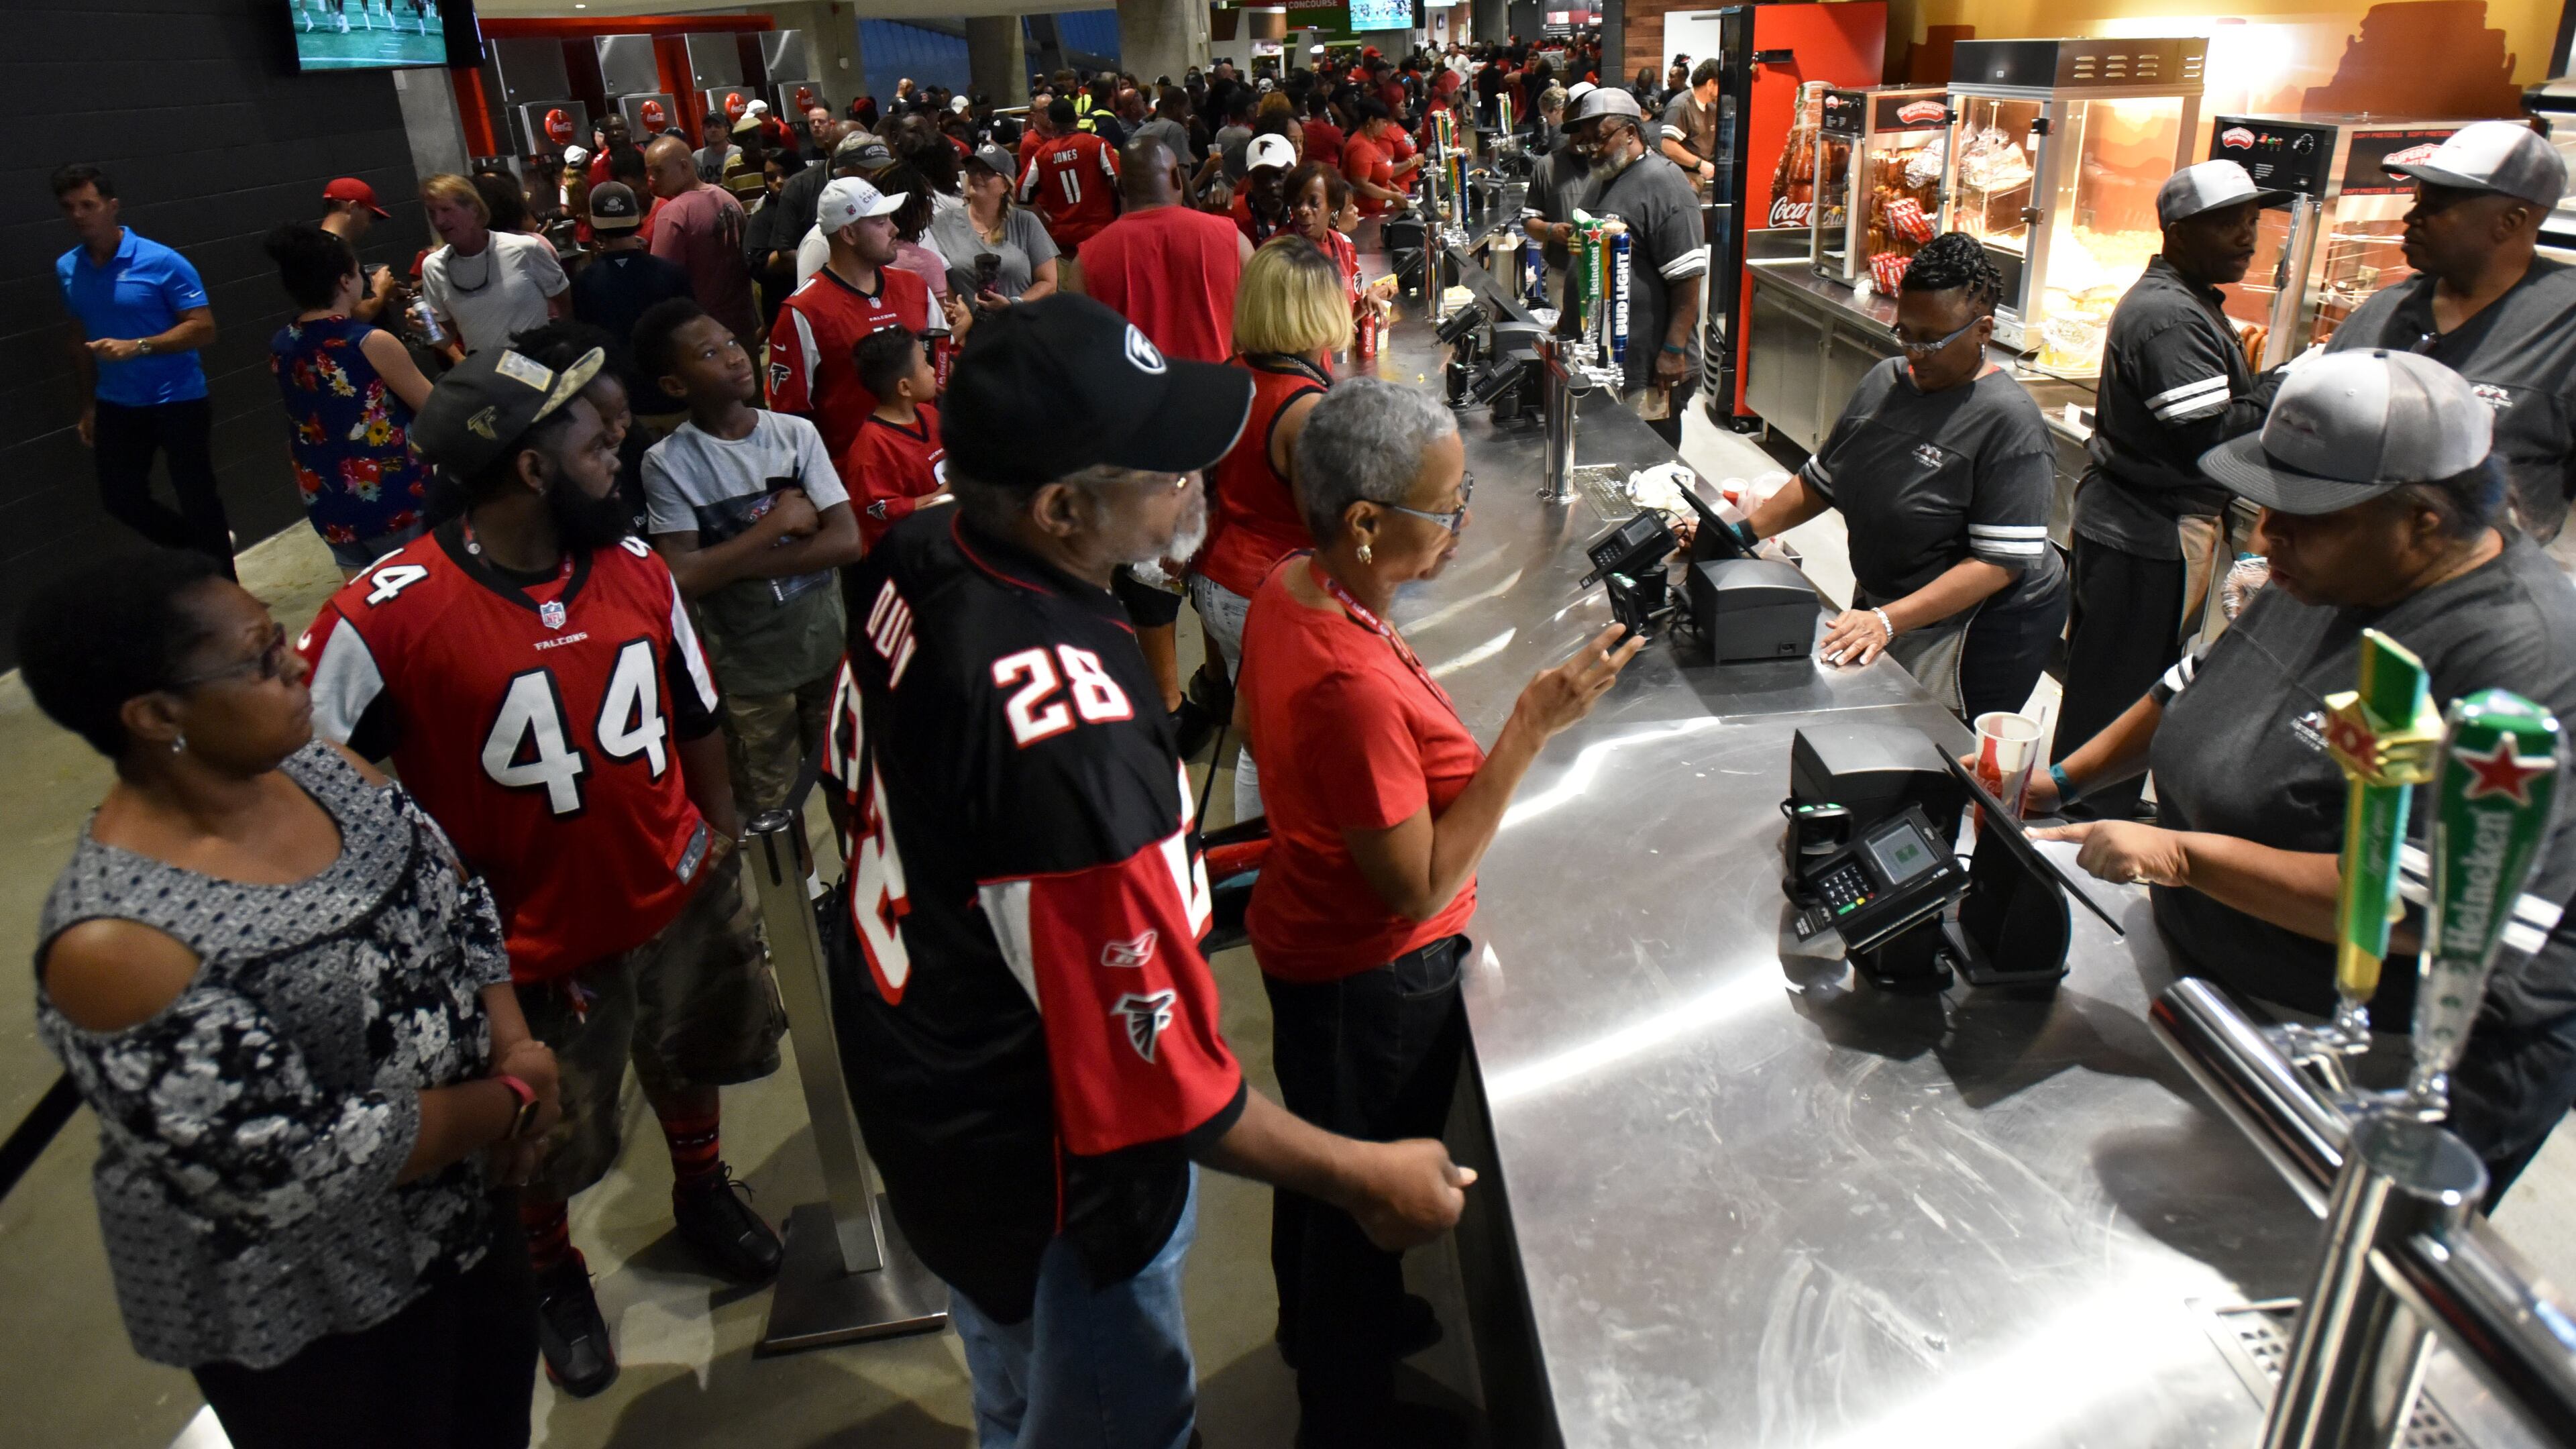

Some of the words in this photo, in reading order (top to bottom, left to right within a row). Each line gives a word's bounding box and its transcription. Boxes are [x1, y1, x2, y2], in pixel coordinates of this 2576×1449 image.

[1289, 0, 1338, 9] CONCOURSE
[1053, 148, 1077, 164] JONES
[1059, 168, 1081, 204] 11
[1589, 246, 1599, 295] Heineken
[1615, 252, 1629, 301] LIGHT
[869, 313, 897, 321] FALCONS
[1615, 301, 1629, 336] BUD
[533, 632, 588, 651] FALCONS
[990, 643, 1135, 750] 28
[482, 640, 666, 815] 44
[2445, 807, 2512, 953] Heineken
